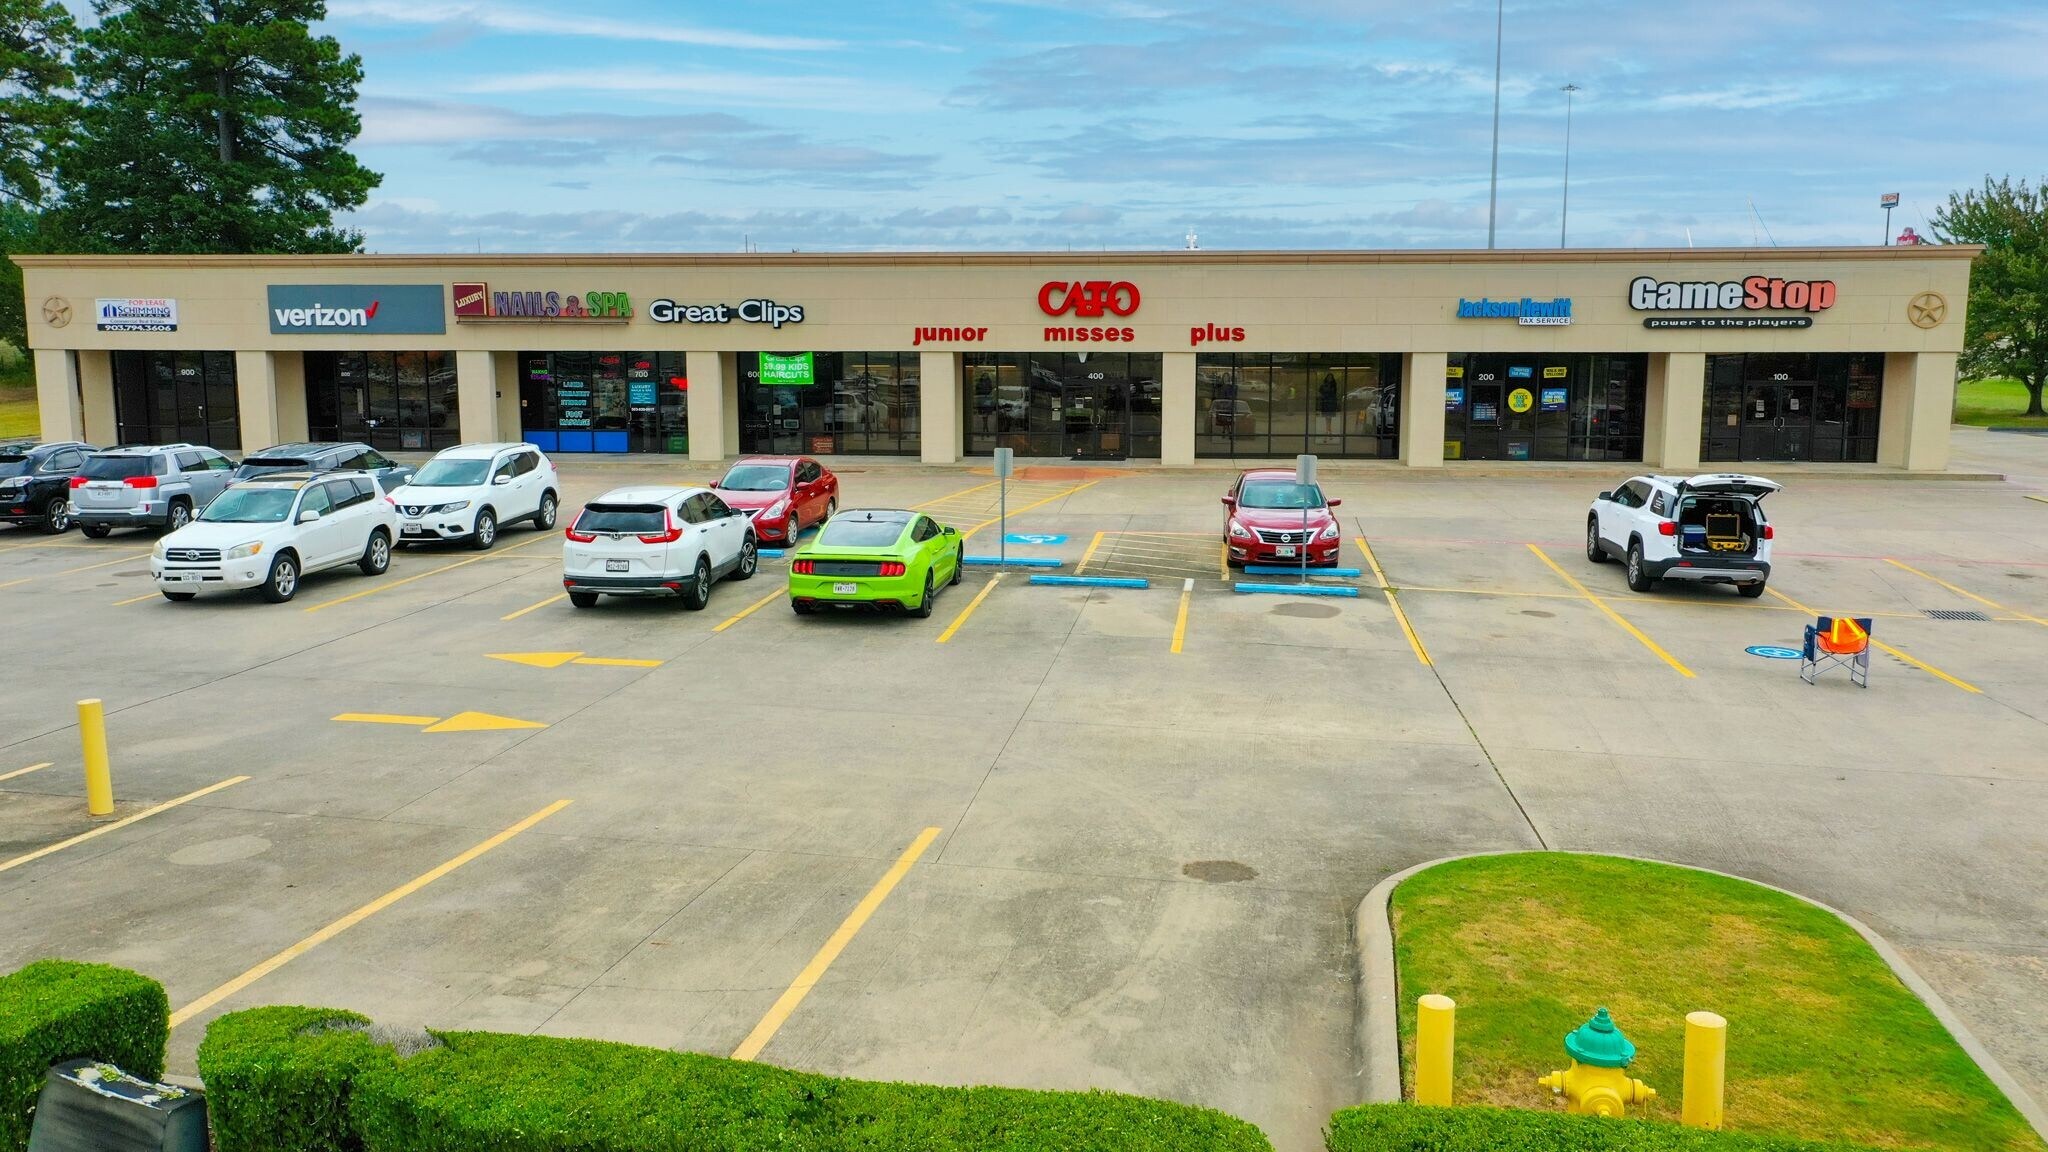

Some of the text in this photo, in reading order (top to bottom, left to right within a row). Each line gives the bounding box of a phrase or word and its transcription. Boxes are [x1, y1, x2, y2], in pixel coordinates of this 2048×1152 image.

[455, 290, 484, 308] LUXURY
[1038, 281, 1141, 317] CATO
[1630, 276, 1837, 312] GameStop
[117, 306, 170, 314] SCHIMMING
[493, 291, 632, 317] NAILS & SPA
[275, 303, 367, 326] verizon
[649, 300, 802, 328] Great Clips
[1651, 317, 1807, 327] power to the players
[913, 323, 1246, 346] junior misses plus
[764, 371, 810, 379] HAIRCUTS
[788, 363, 809, 371] KIDS
[1088, 372, 1104, 380] 400
[1773, 373, 1789, 381] 100
